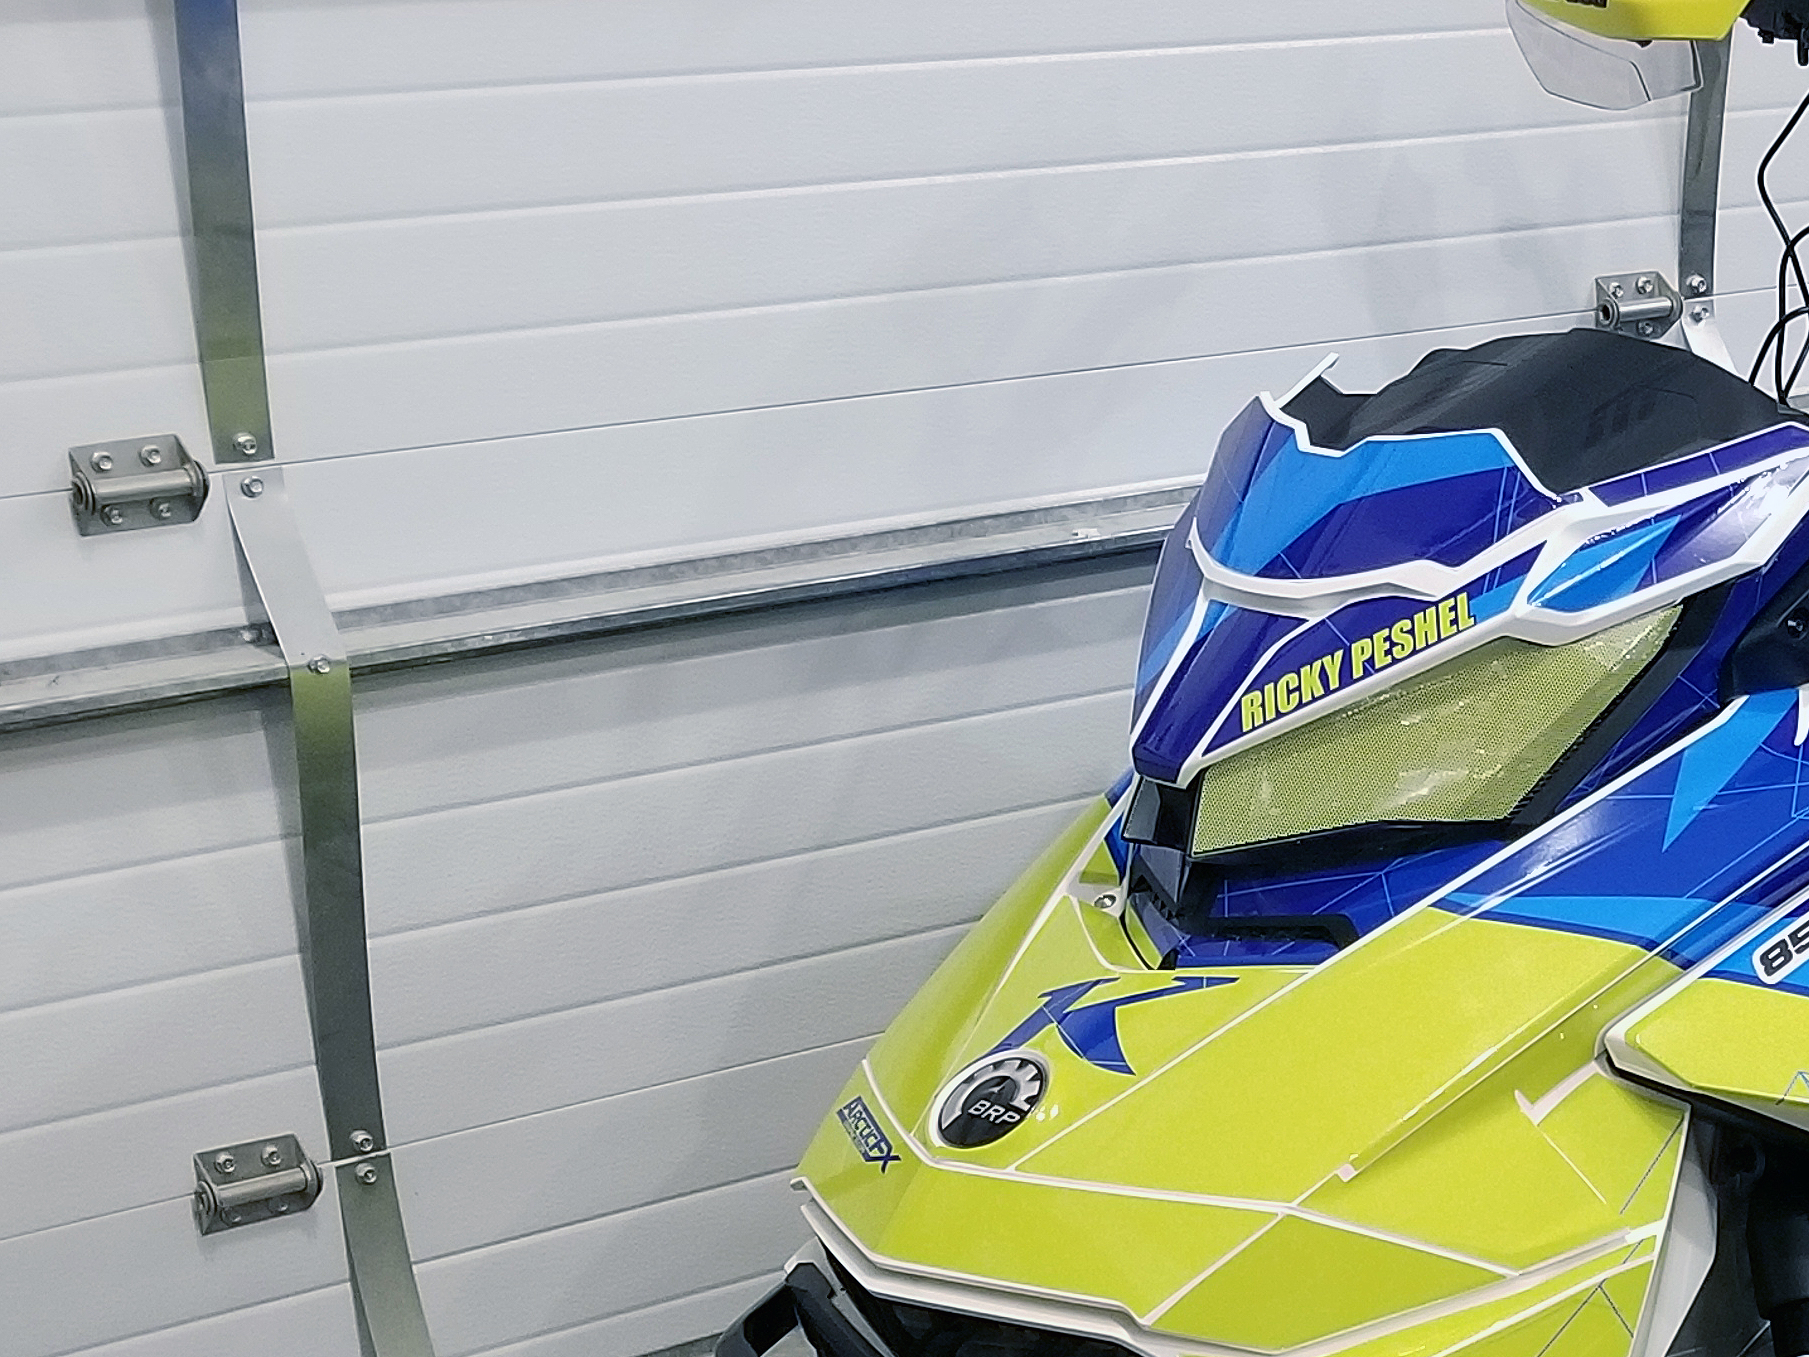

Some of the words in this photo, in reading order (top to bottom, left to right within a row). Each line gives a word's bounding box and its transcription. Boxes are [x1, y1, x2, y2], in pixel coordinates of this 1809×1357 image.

[1240, 648, 1343, 734] RICKY
[1351, 592, 1477, 681] PESHEL
[968, 1100, 1021, 1124] BRP
